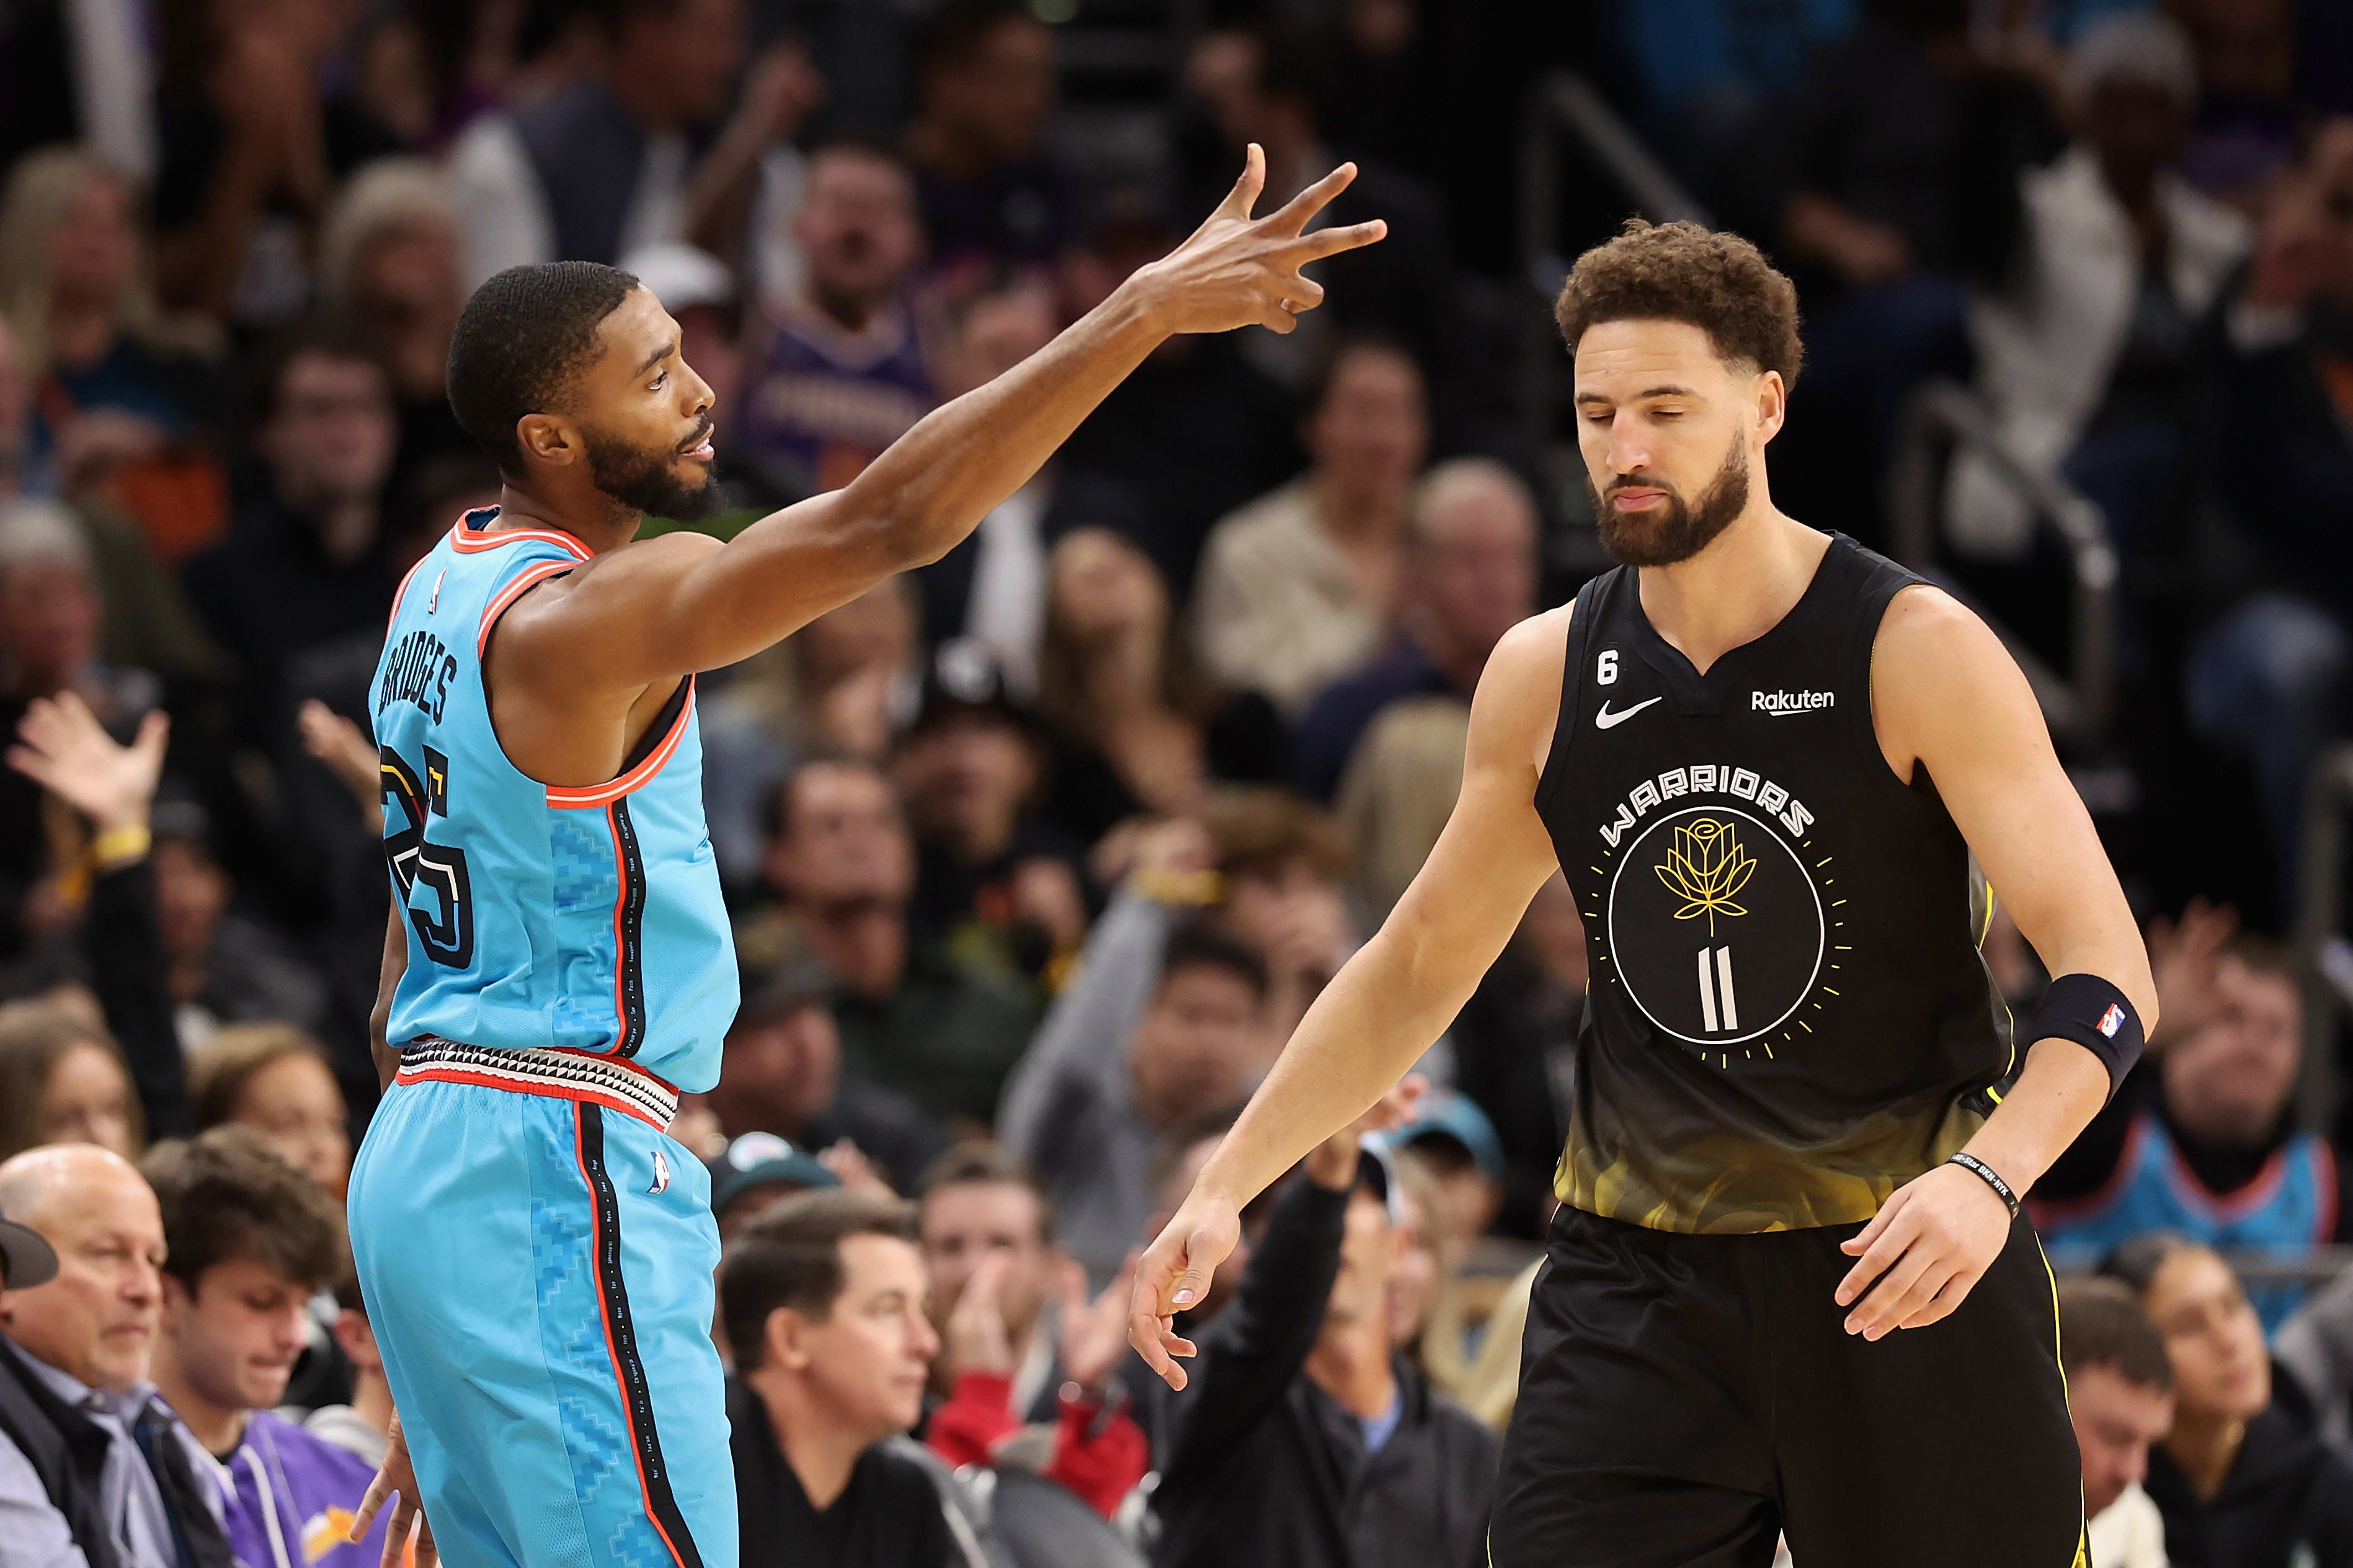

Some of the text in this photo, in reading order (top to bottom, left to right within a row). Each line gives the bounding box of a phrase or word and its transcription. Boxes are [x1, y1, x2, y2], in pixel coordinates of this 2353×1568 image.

[378, 631, 457, 727] BRIDGES
[1597, 649, 1619, 686] 6
[1751, 689, 1835, 711] Rakuten
[1599, 764, 1815, 848] WARRIORS
[380, 743, 474, 969] 25
[1698, 946, 1738, 1032] 11
